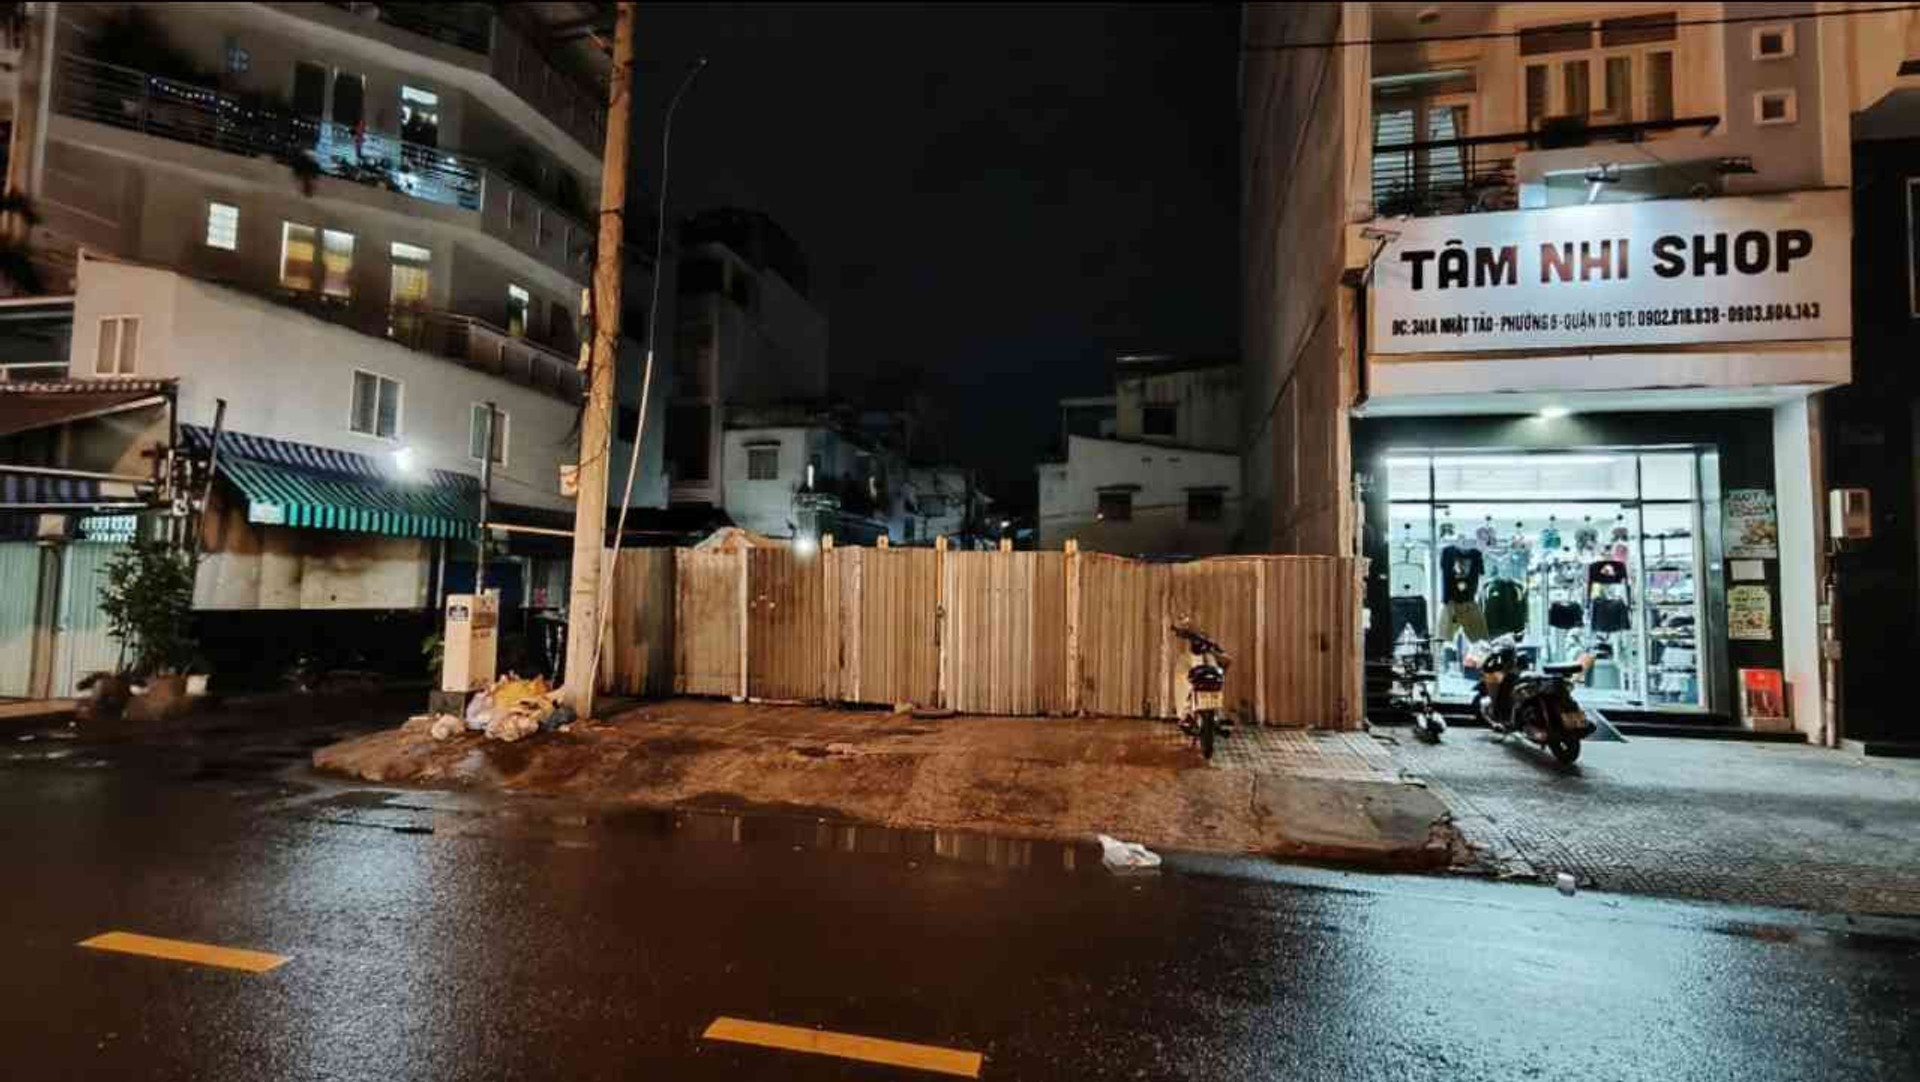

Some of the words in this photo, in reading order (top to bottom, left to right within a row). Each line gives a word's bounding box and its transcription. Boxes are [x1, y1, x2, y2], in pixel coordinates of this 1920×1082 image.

[1400, 239, 1518, 290] TÂM
[1541, 239, 1630, 283] NHI
[1652, 229, 1814, 278] SHOP
[1599, 311, 1612, 328] 10
